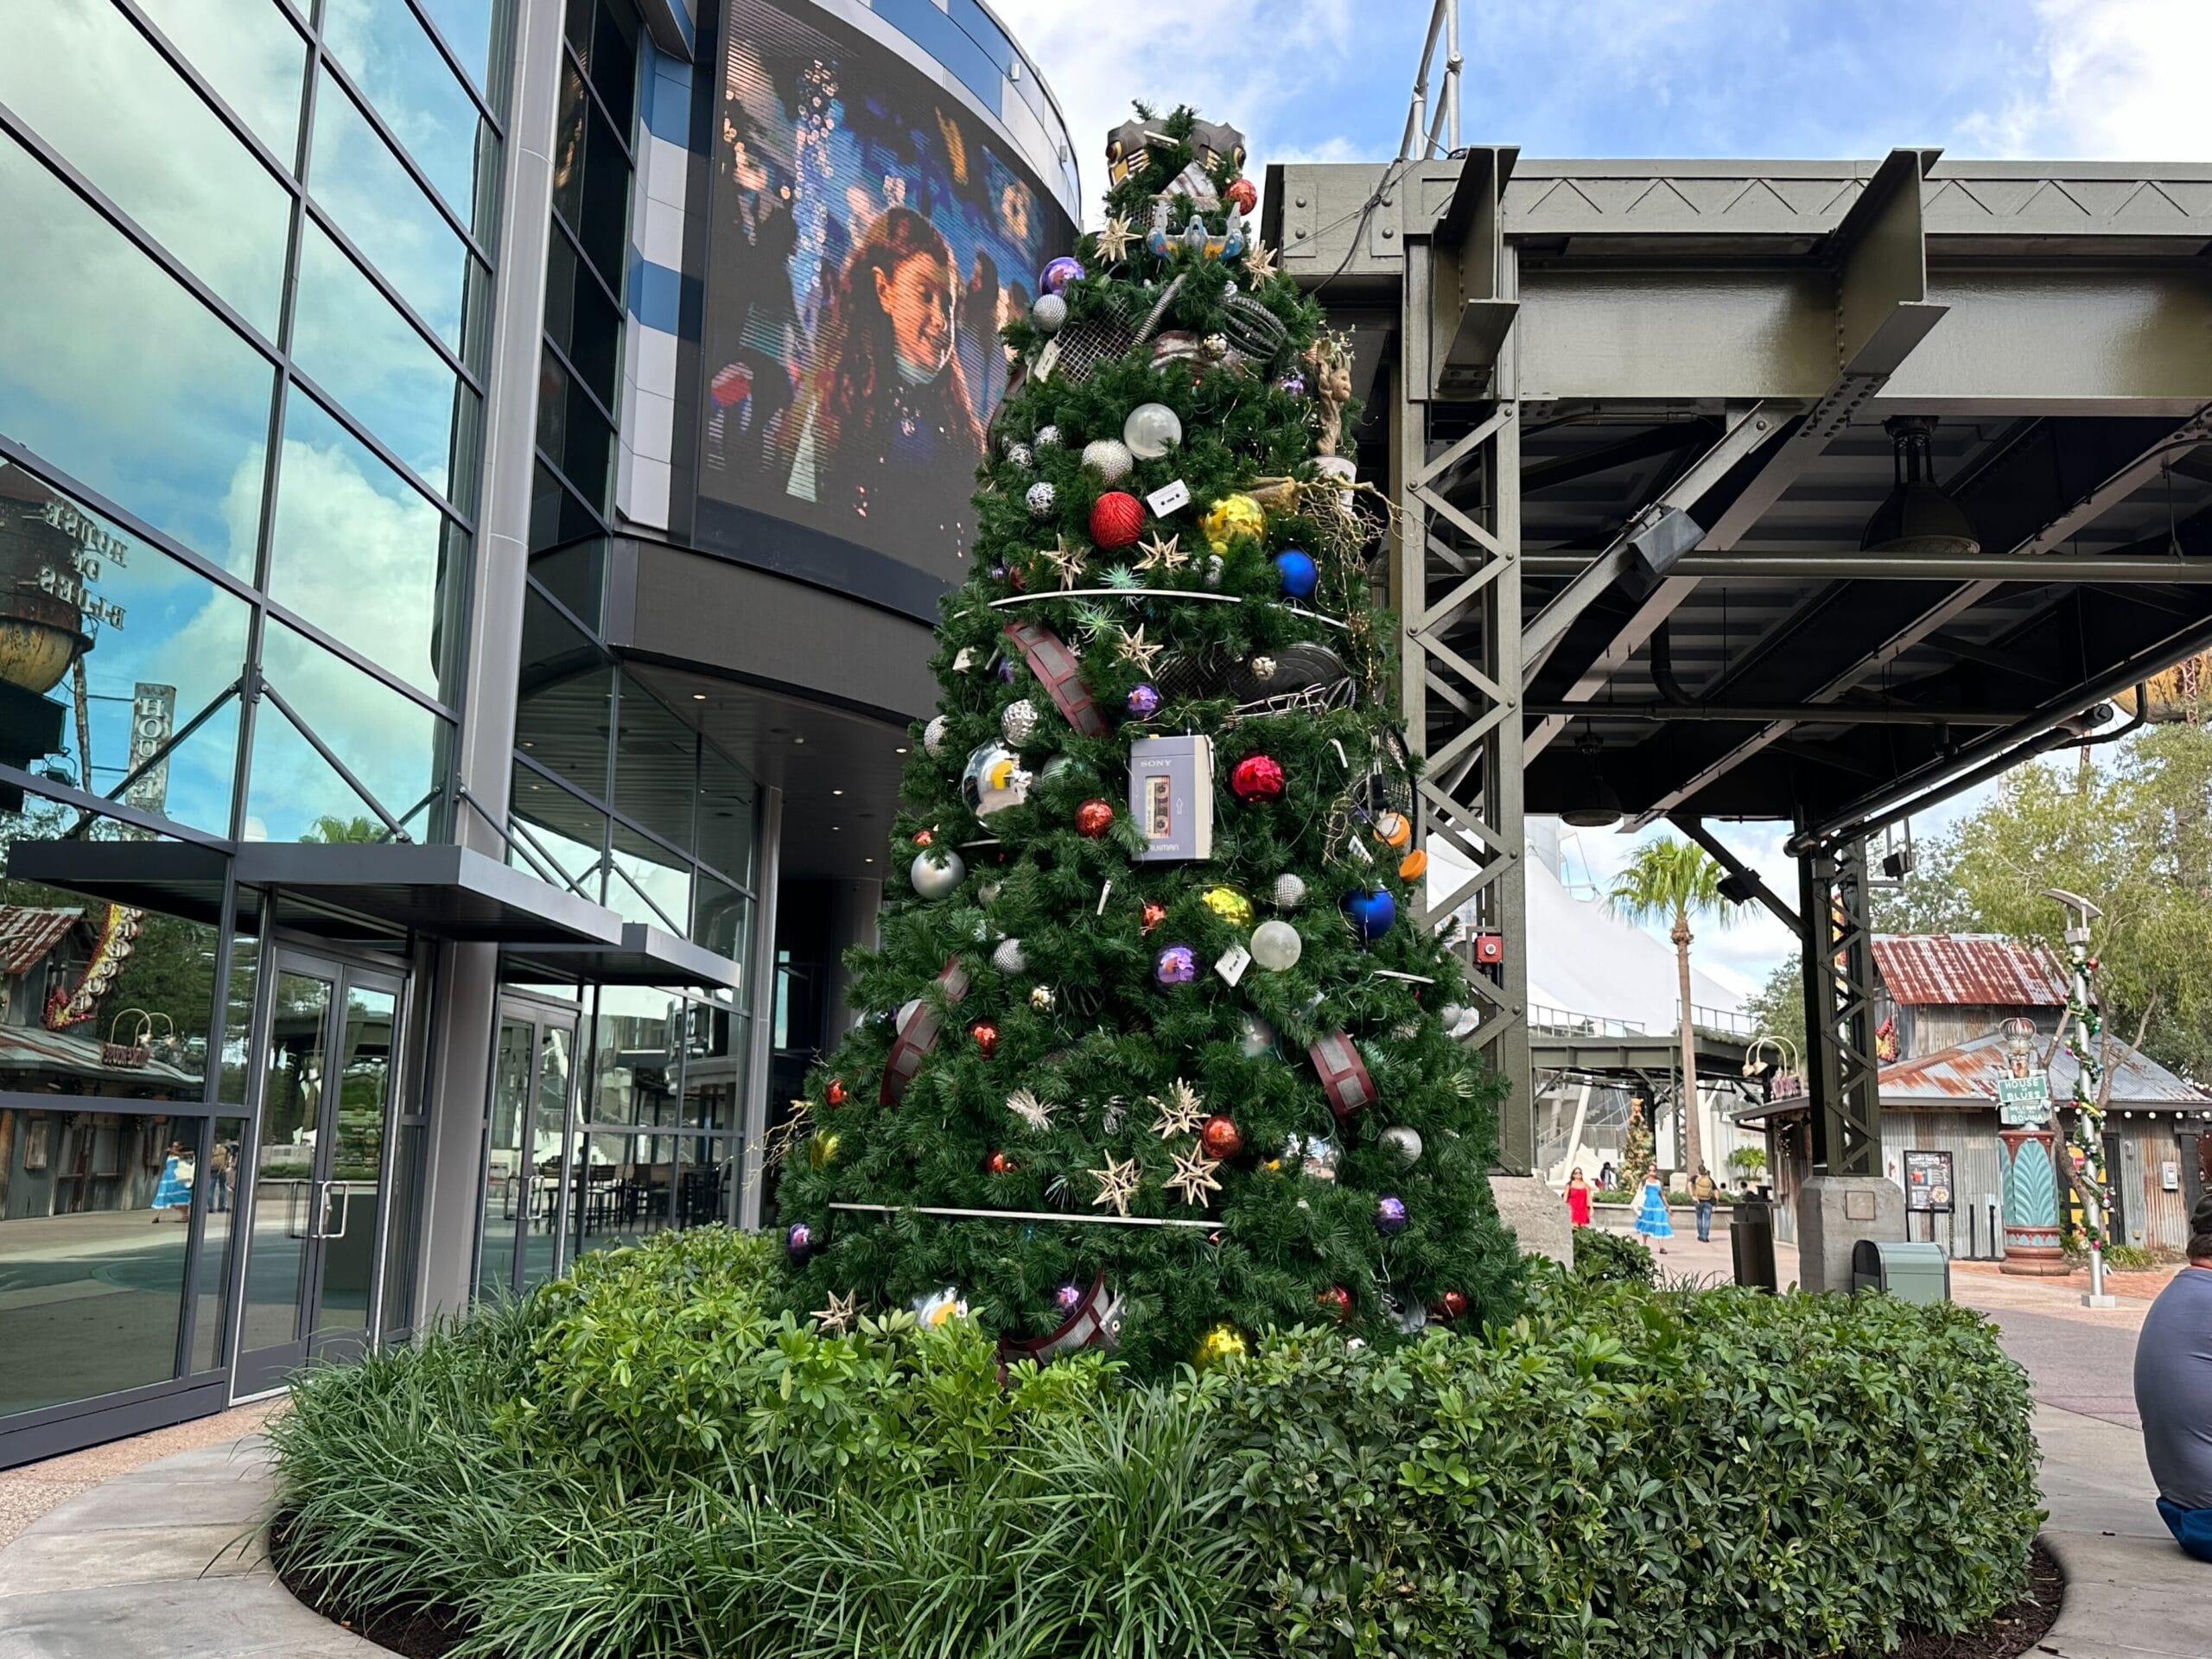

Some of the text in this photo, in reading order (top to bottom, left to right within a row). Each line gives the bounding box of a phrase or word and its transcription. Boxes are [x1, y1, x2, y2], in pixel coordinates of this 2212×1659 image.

[1148, 843, 1179, 852] ALKMAN
[2005, 1078, 2039, 1089] HOUSE
[2006, 1090, 2041, 1100] BLUES
